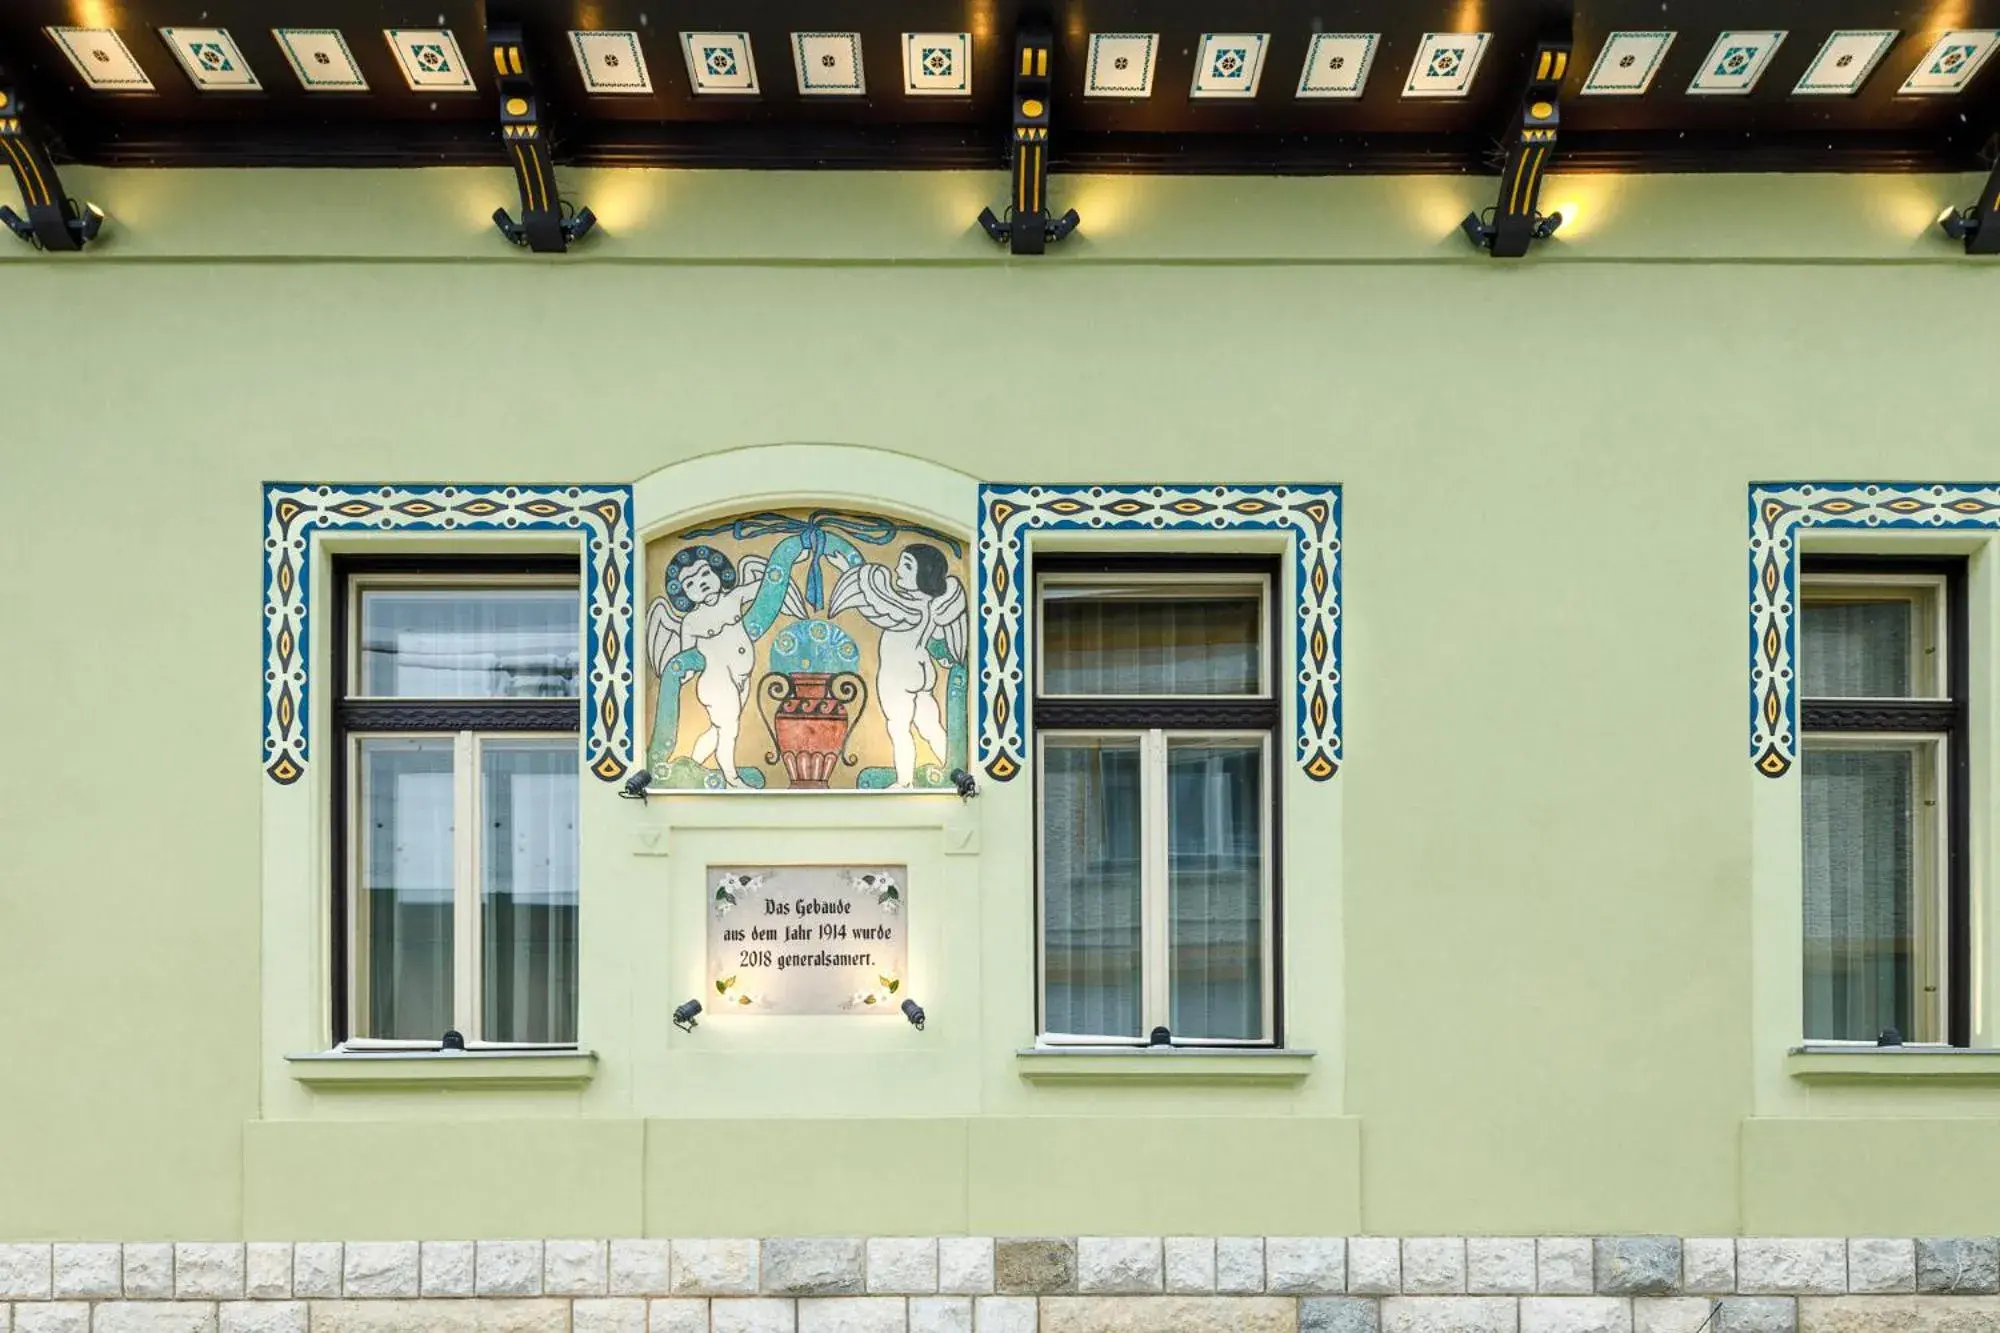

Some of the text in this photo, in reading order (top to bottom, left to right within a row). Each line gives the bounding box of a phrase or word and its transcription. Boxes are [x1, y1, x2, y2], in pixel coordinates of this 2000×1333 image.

[764, 898, 791, 915] Das
[722, 923, 892, 942] aus dem Jahr 1914 wurde
[740, 950, 772, 967] 2018
